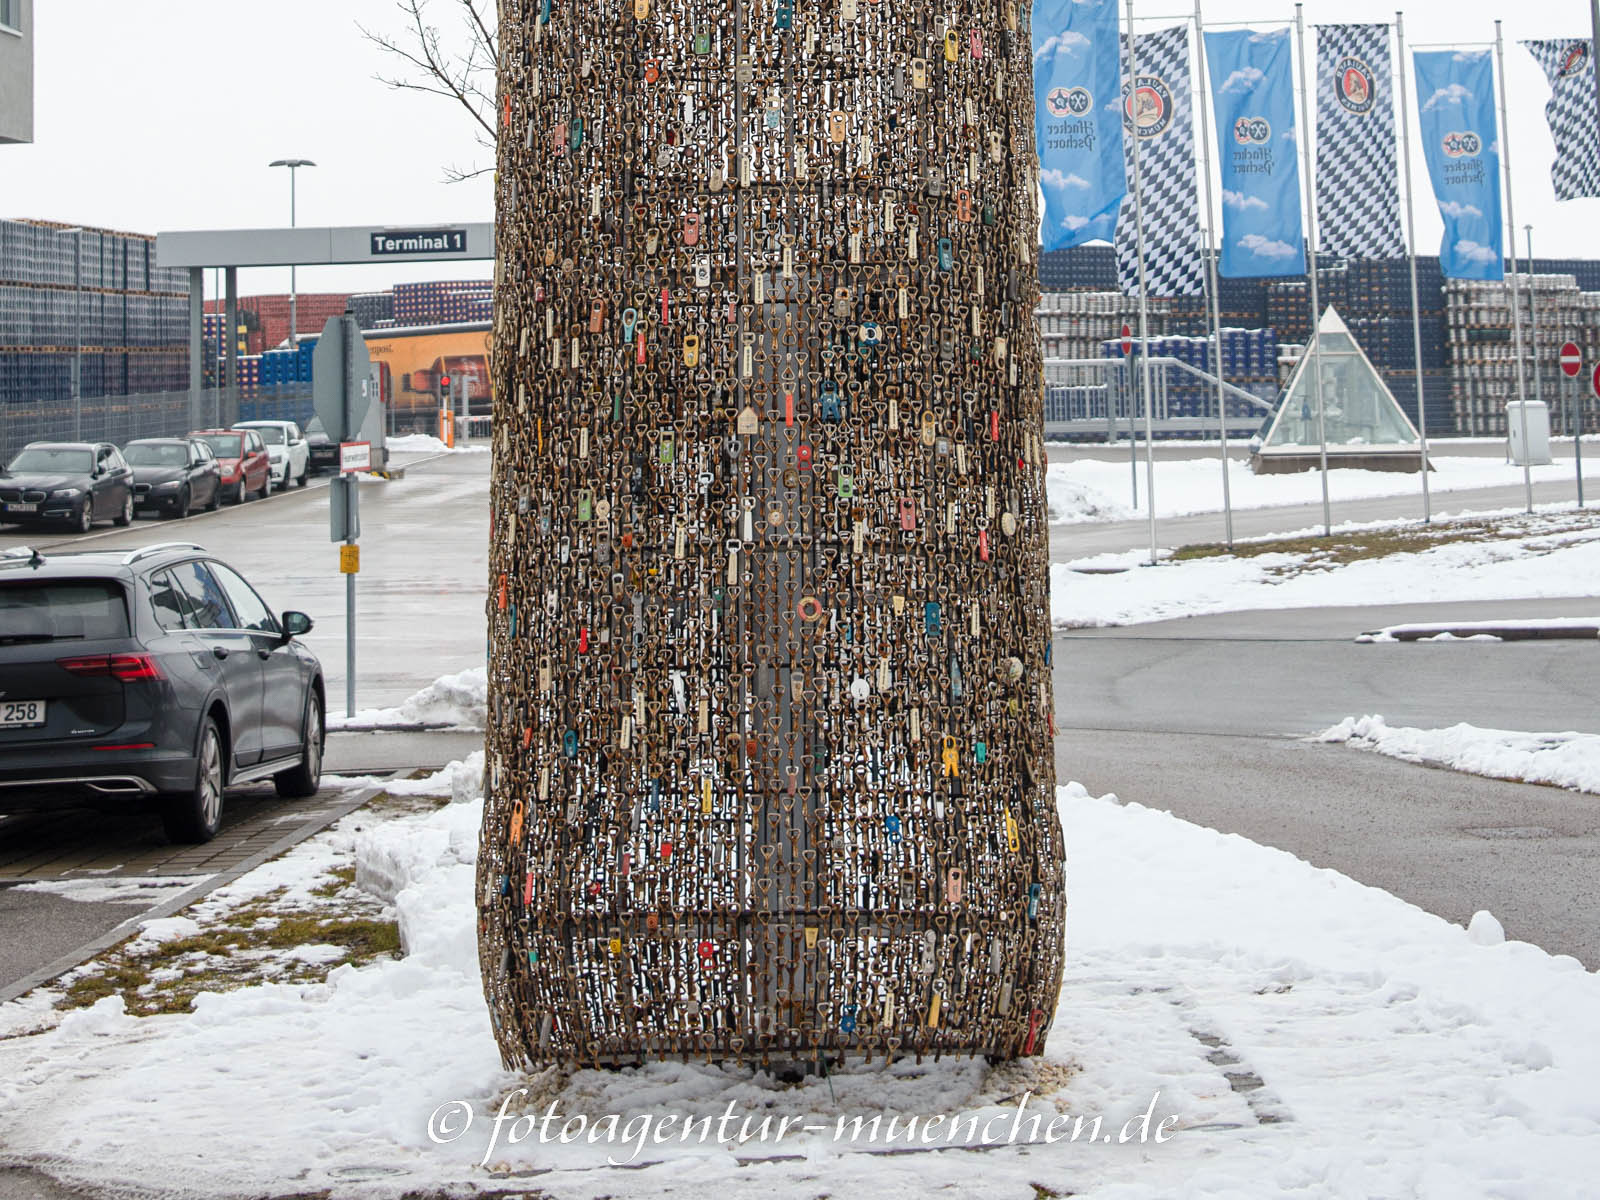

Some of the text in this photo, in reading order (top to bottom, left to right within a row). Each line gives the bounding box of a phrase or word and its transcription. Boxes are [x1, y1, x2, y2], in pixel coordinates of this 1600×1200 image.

[375, 233, 461, 252] Terminal 1
[4, 703, 37, 721] 258
